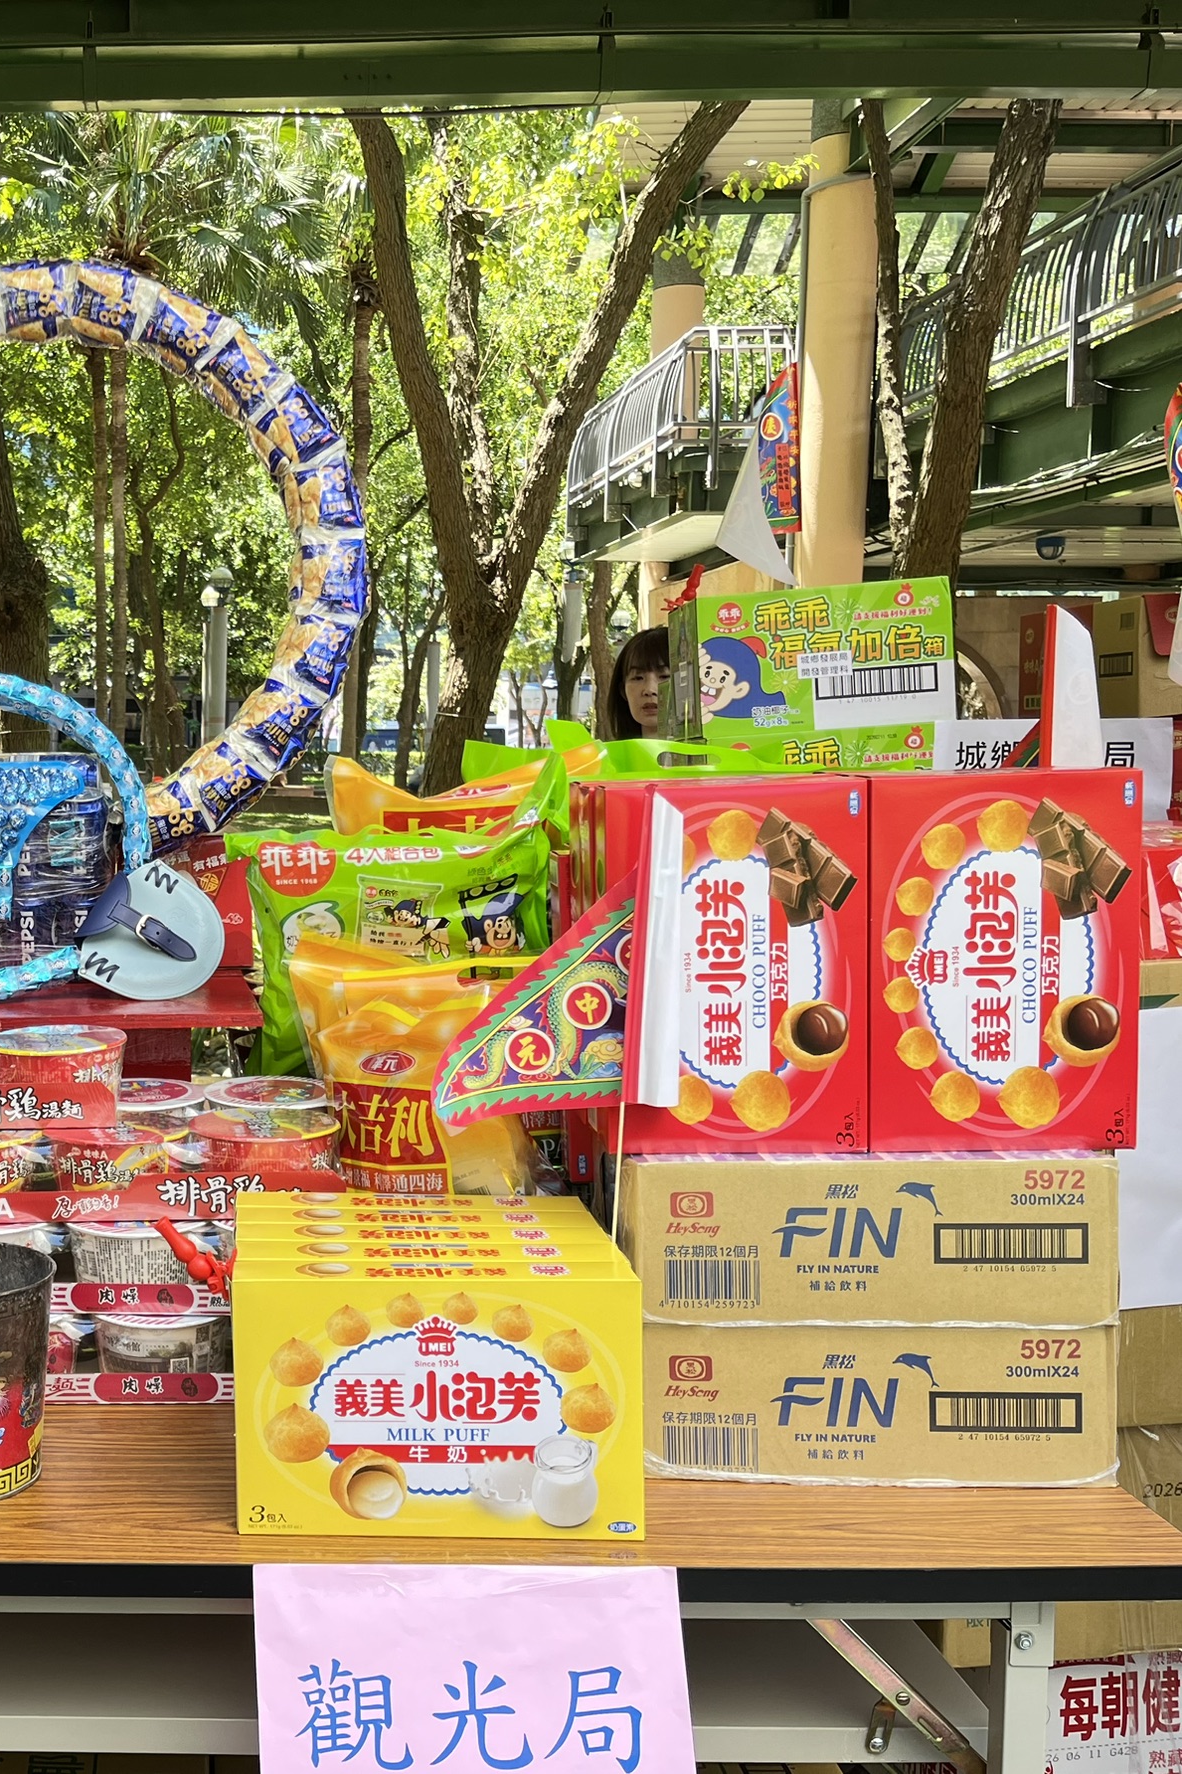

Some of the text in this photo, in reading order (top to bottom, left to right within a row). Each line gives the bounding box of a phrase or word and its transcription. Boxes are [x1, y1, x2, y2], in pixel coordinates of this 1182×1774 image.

[755, 597, 830, 635] 乖乖
[261, 846, 330, 876] 乖乖
[344, 847, 441, 864] 4人組合包
[695, 878, 748, 1067] 義美小泡芙
[752, 913, 767, 1029] CHOCO PUFF
[770, 942, 788, 1001] 巧克力
[962, 870, 1018, 1063] 義美小泡芙
[1021, 906, 1038, 1025] CHOCO PUFF
[1041, 935, 1060, 996] 巧克力
[516, 1037, 548, 1067] 元
[1024, 1169, 1086, 1190] 5972
[824, 1184, 859, 1200] 黑松
[1010, 1193, 1085, 1206] 300mlX24
[771, 1207, 902, 1259] FIN
[664, 1245, 759, 1258] 保存期限12個月
[796, 1264, 879, 1274] FLY IN NATURE
[809, 1280, 867, 1291] 補給飲料
[1020, 1339, 1082, 1359] 5972
[414, 1359, 460, 1368] Since 1934
[822, 1354, 857, 1370] 黑松
[1006, 1365, 1079, 1378] 300mlX24
[334, 1370, 541, 1424] 義美小泡芙
[770, 1377, 899, 1428] FIN
[662, 1411, 757, 1426] 保存期限12個月
[386, 1427, 491, 1442] MILK PUFF
[795, 1433, 876, 1443] FLY IN NATURE
[408, 1446, 468, 1464] 牛奶
[807, 1449, 865, 1460] 補給飲料
[1060, 1666, 1182, 1741] 每朝健
[294, 1658, 643, 1774] 觀光局
[1066, 1751, 1081, 1761] 06
